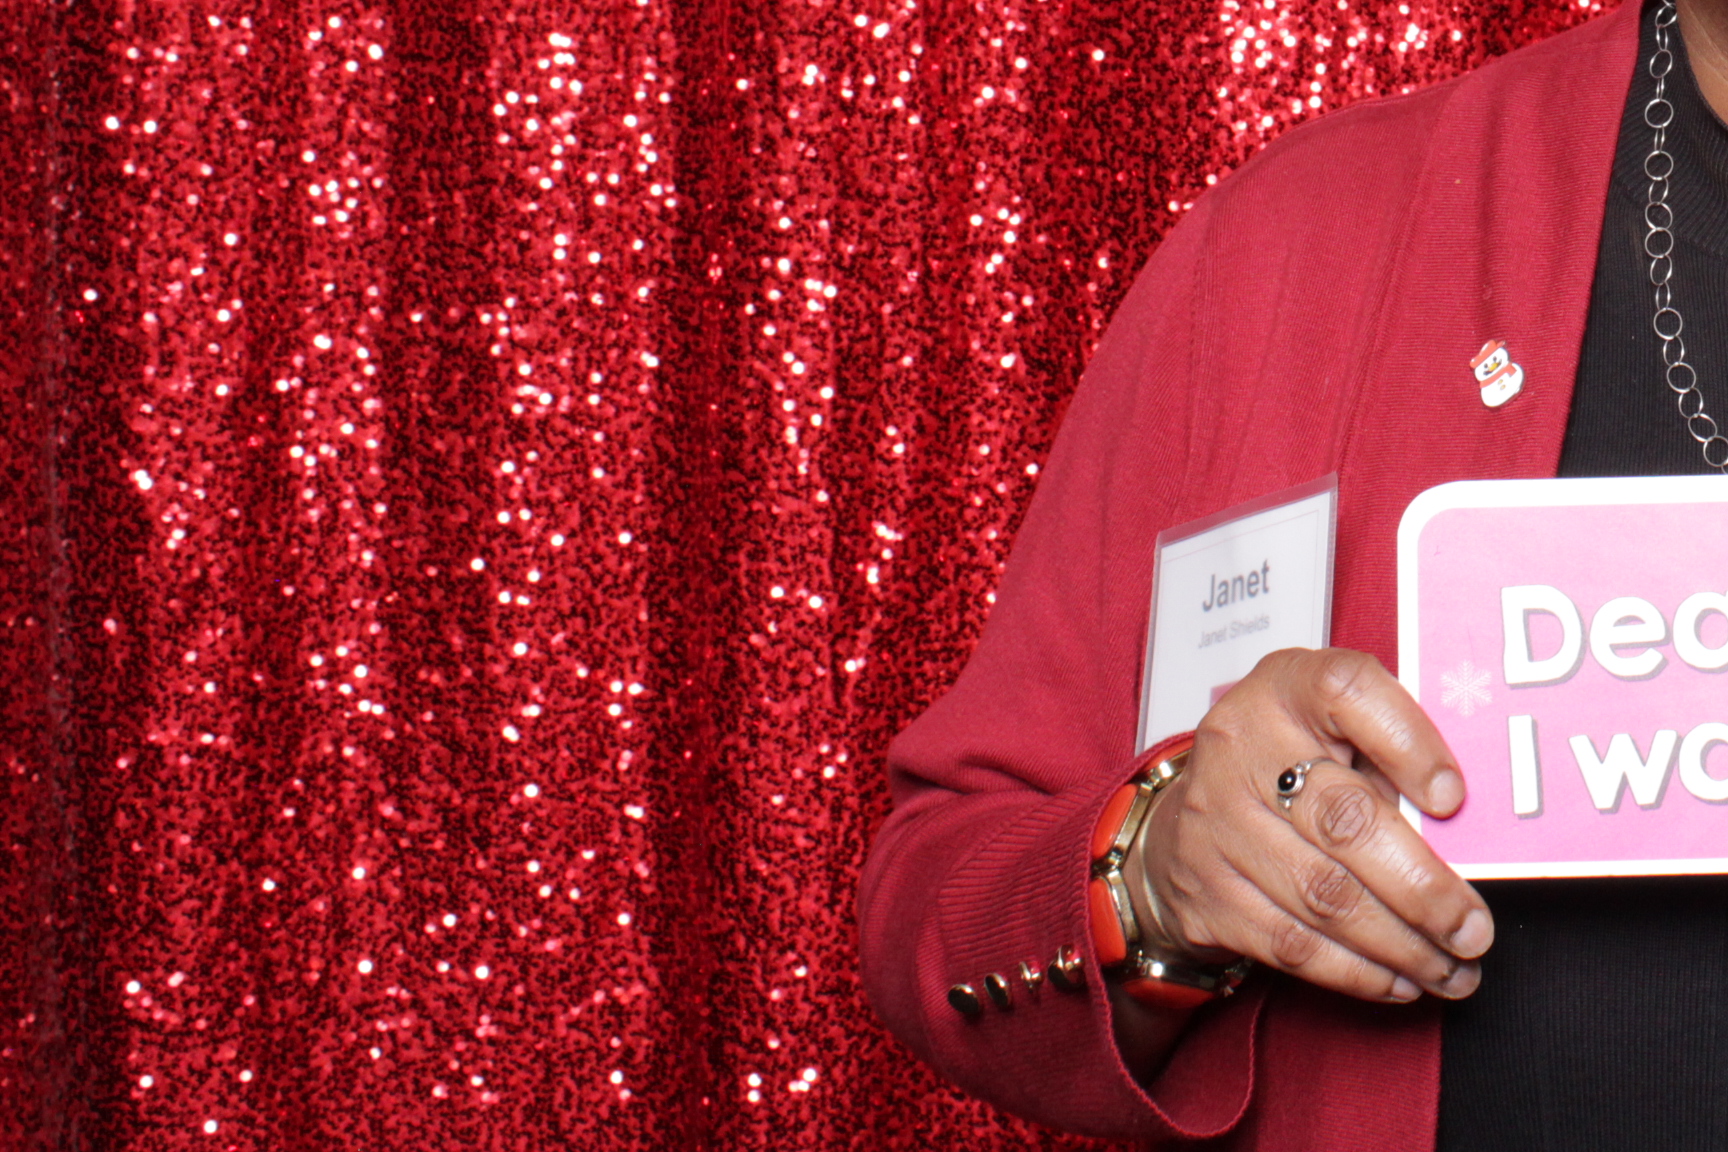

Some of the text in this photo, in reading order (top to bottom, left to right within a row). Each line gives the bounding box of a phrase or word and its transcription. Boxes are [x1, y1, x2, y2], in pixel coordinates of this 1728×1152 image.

[1203, 559, 1269, 612] Janet
[1199, 625, 1228, 648] Janet
[1508, 713, 1544, 816] I
